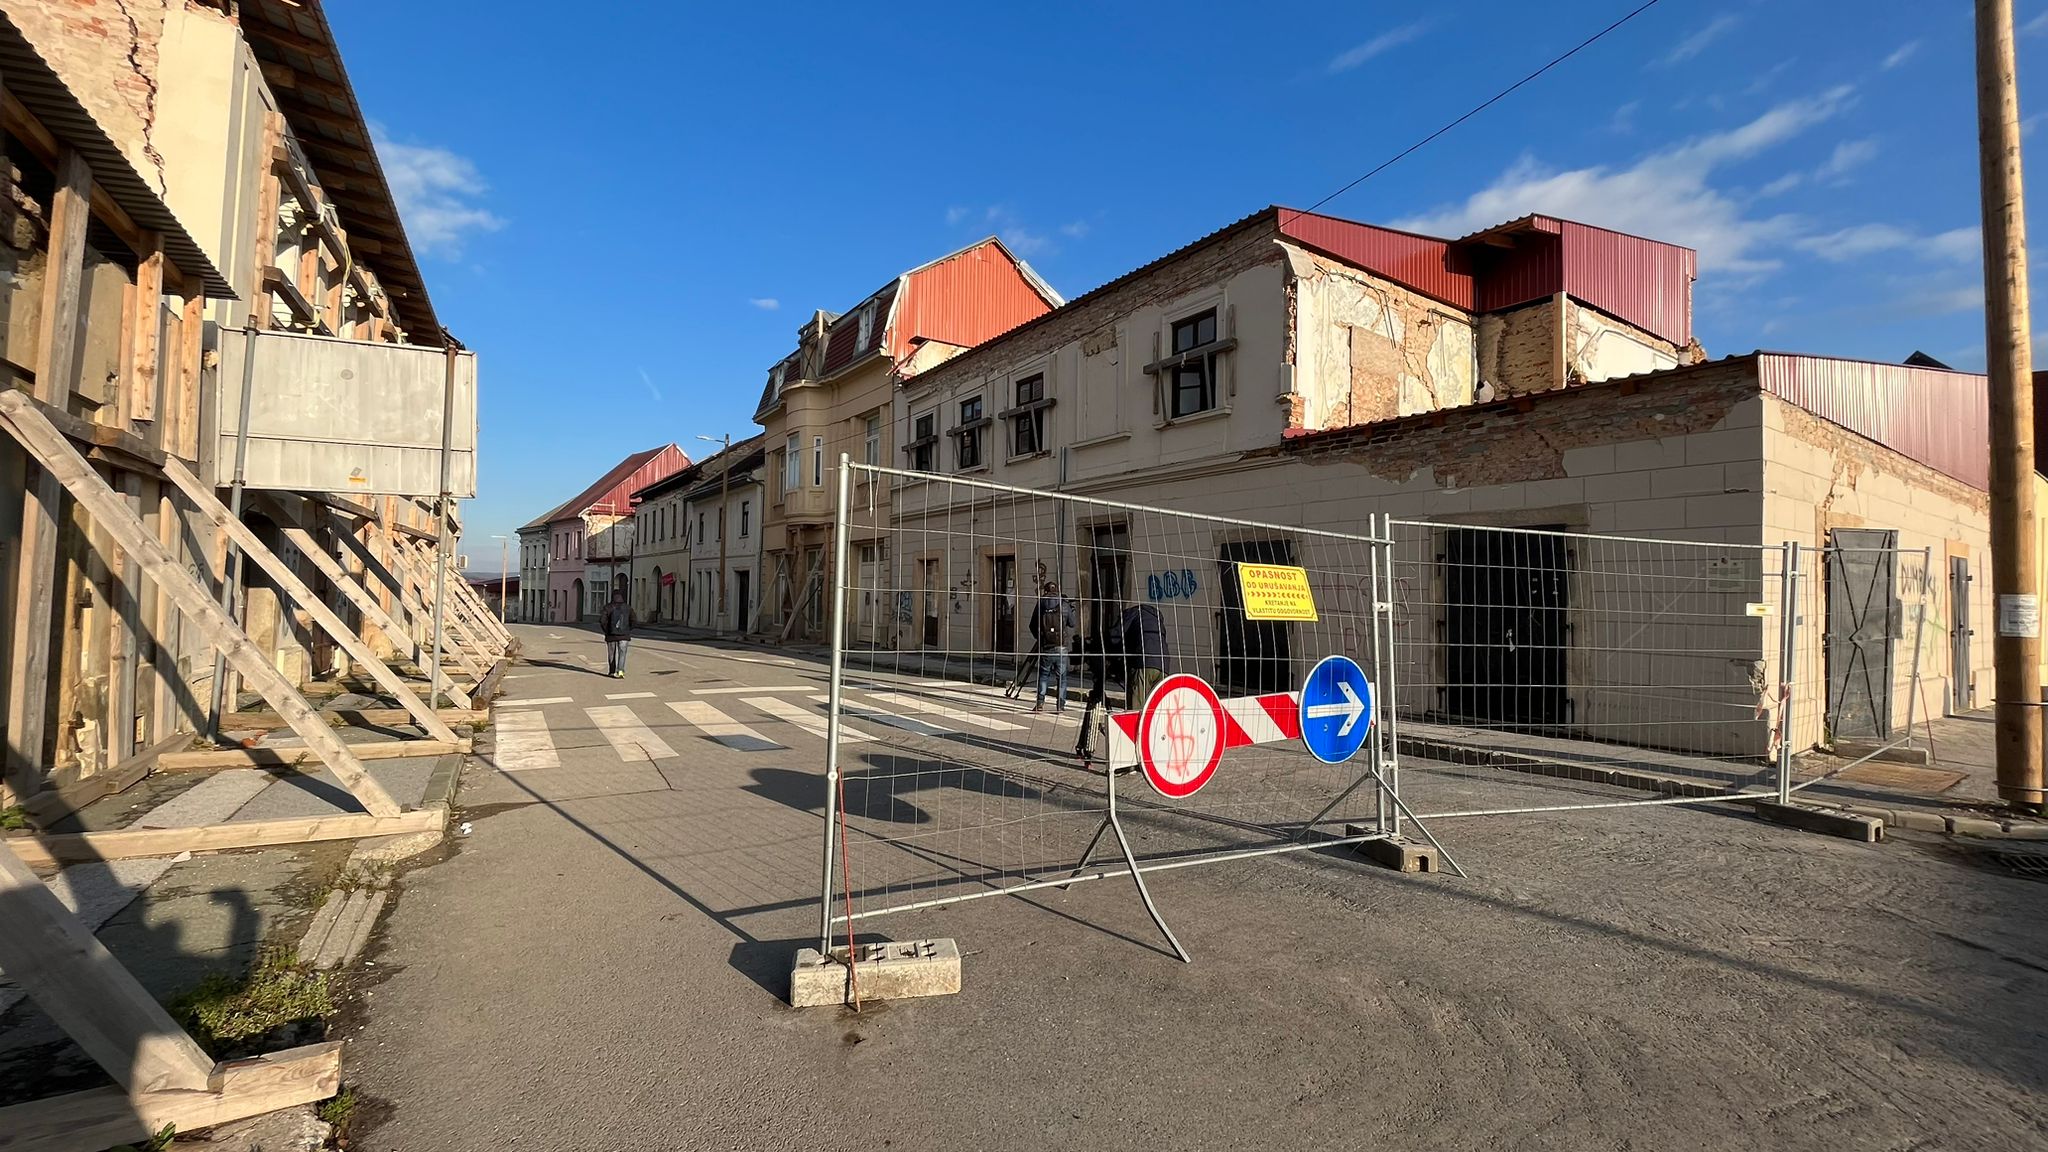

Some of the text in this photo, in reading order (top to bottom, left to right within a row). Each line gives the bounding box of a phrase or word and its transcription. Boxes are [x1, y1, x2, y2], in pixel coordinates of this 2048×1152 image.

[1249, 569, 1297, 581] OPASNOST
[1246, 581, 1306, 592] OD URUŠAVANJA
